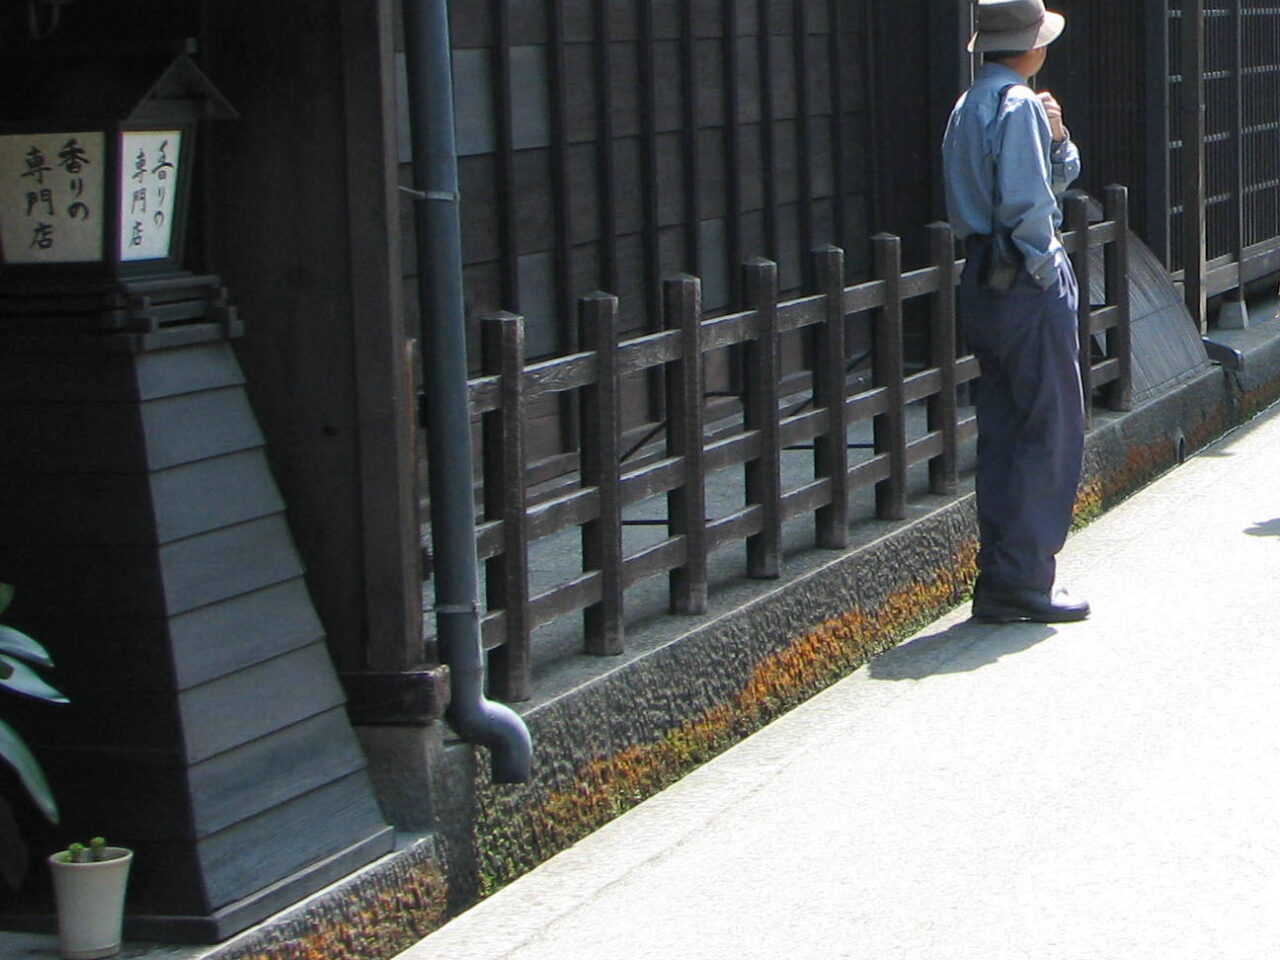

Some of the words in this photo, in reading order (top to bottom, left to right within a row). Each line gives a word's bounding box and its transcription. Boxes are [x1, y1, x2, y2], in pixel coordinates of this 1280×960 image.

[21, 146, 54, 249] 専門店
[58, 138, 90, 221] 香りの
[129, 148, 147, 247] 専門店
[152, 140, 174, 228] 香りの
